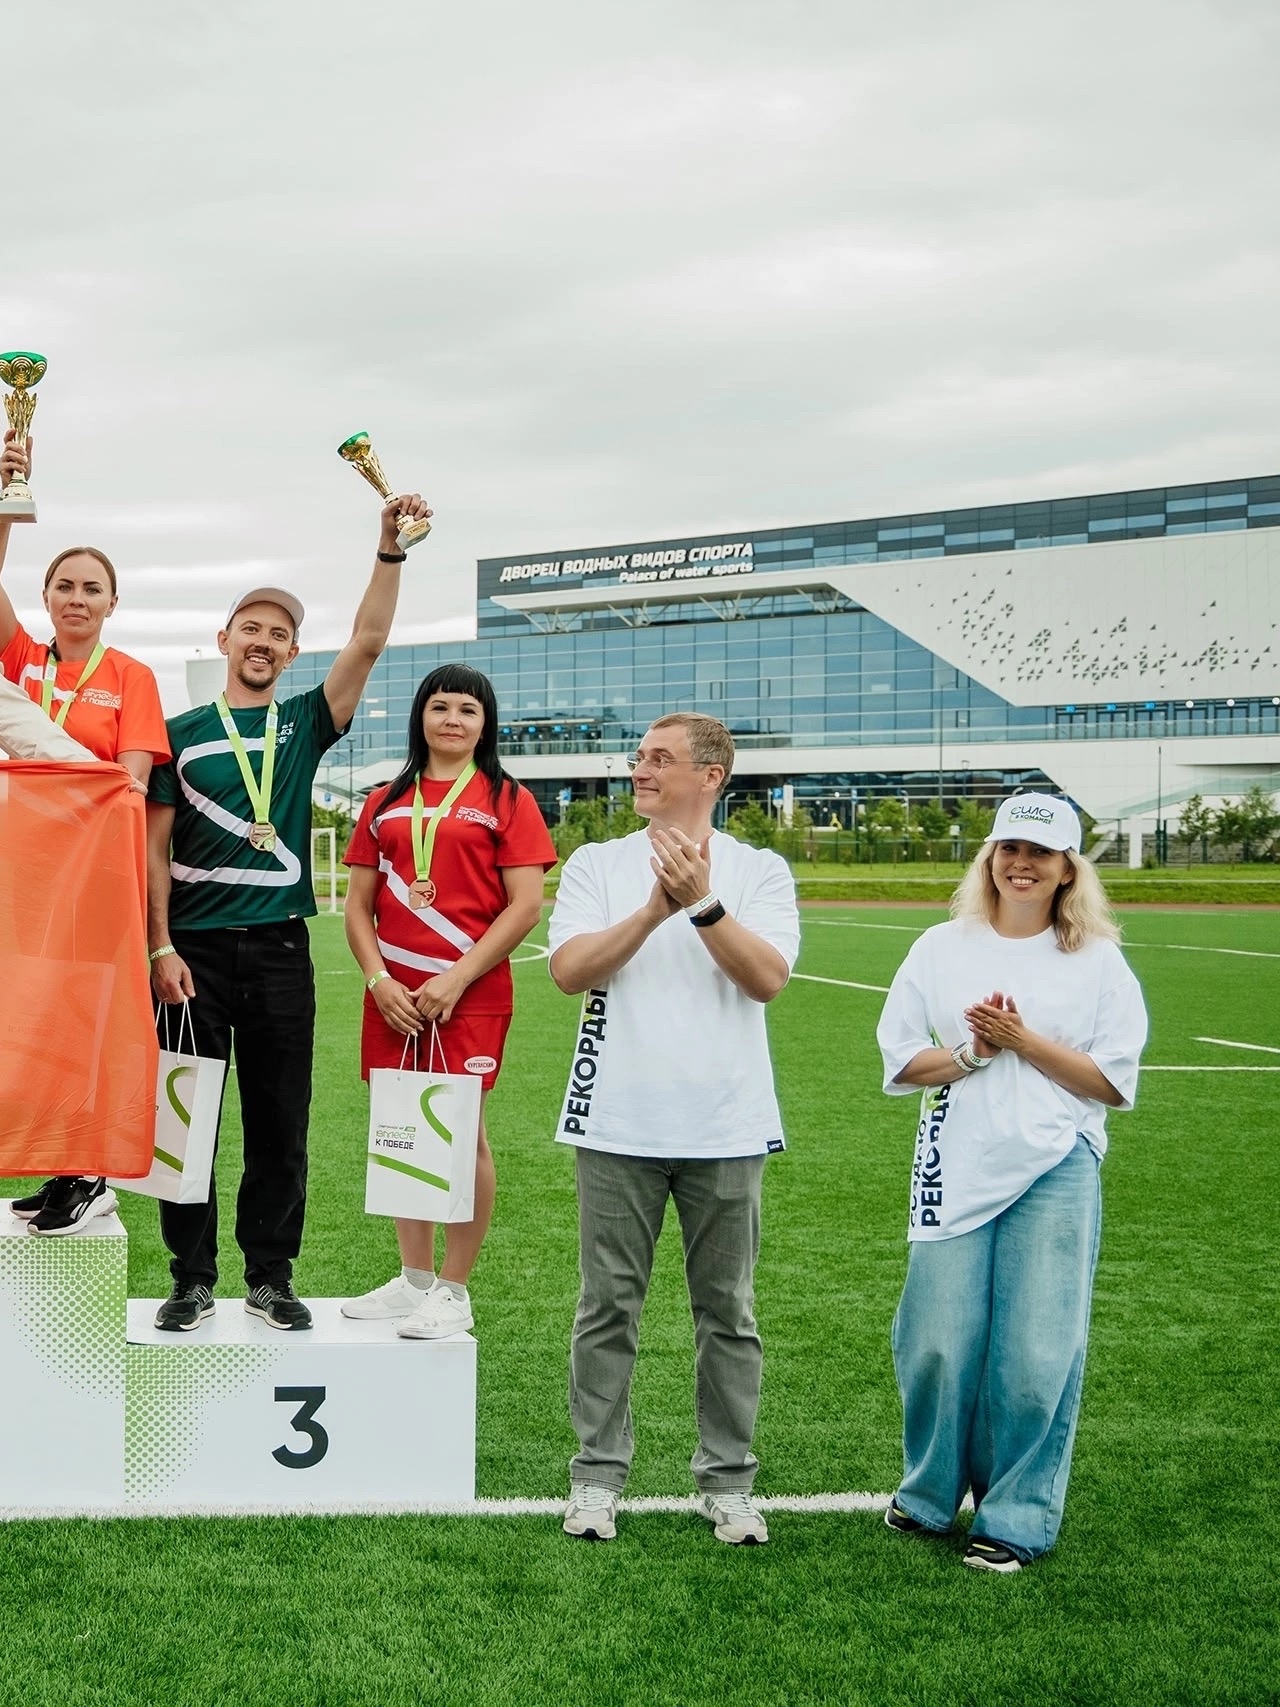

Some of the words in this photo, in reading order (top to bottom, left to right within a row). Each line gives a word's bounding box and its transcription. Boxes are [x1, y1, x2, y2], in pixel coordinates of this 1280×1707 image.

[499, 562, 560, 583] ДВОРЕЦ
[562, 554, 629, 575] ВОДНЫХ
[630, 547, 687, 569] ВИДОВ
[688, 542, 754, 563] СПОРТА
[619, 569, 657, 584] Palace
[658, 567, 674, 581] of
[675, 565, 710, 579] water
[711, 561, 754, 578] sports
[563, 988, 608, 1136] РЕКОРДЫ
[375, 1138, 381, 1146] К
[383, 1139, 415, 1150] ПОБЕДЕ
[271, 1386, 329, 1469] 3
